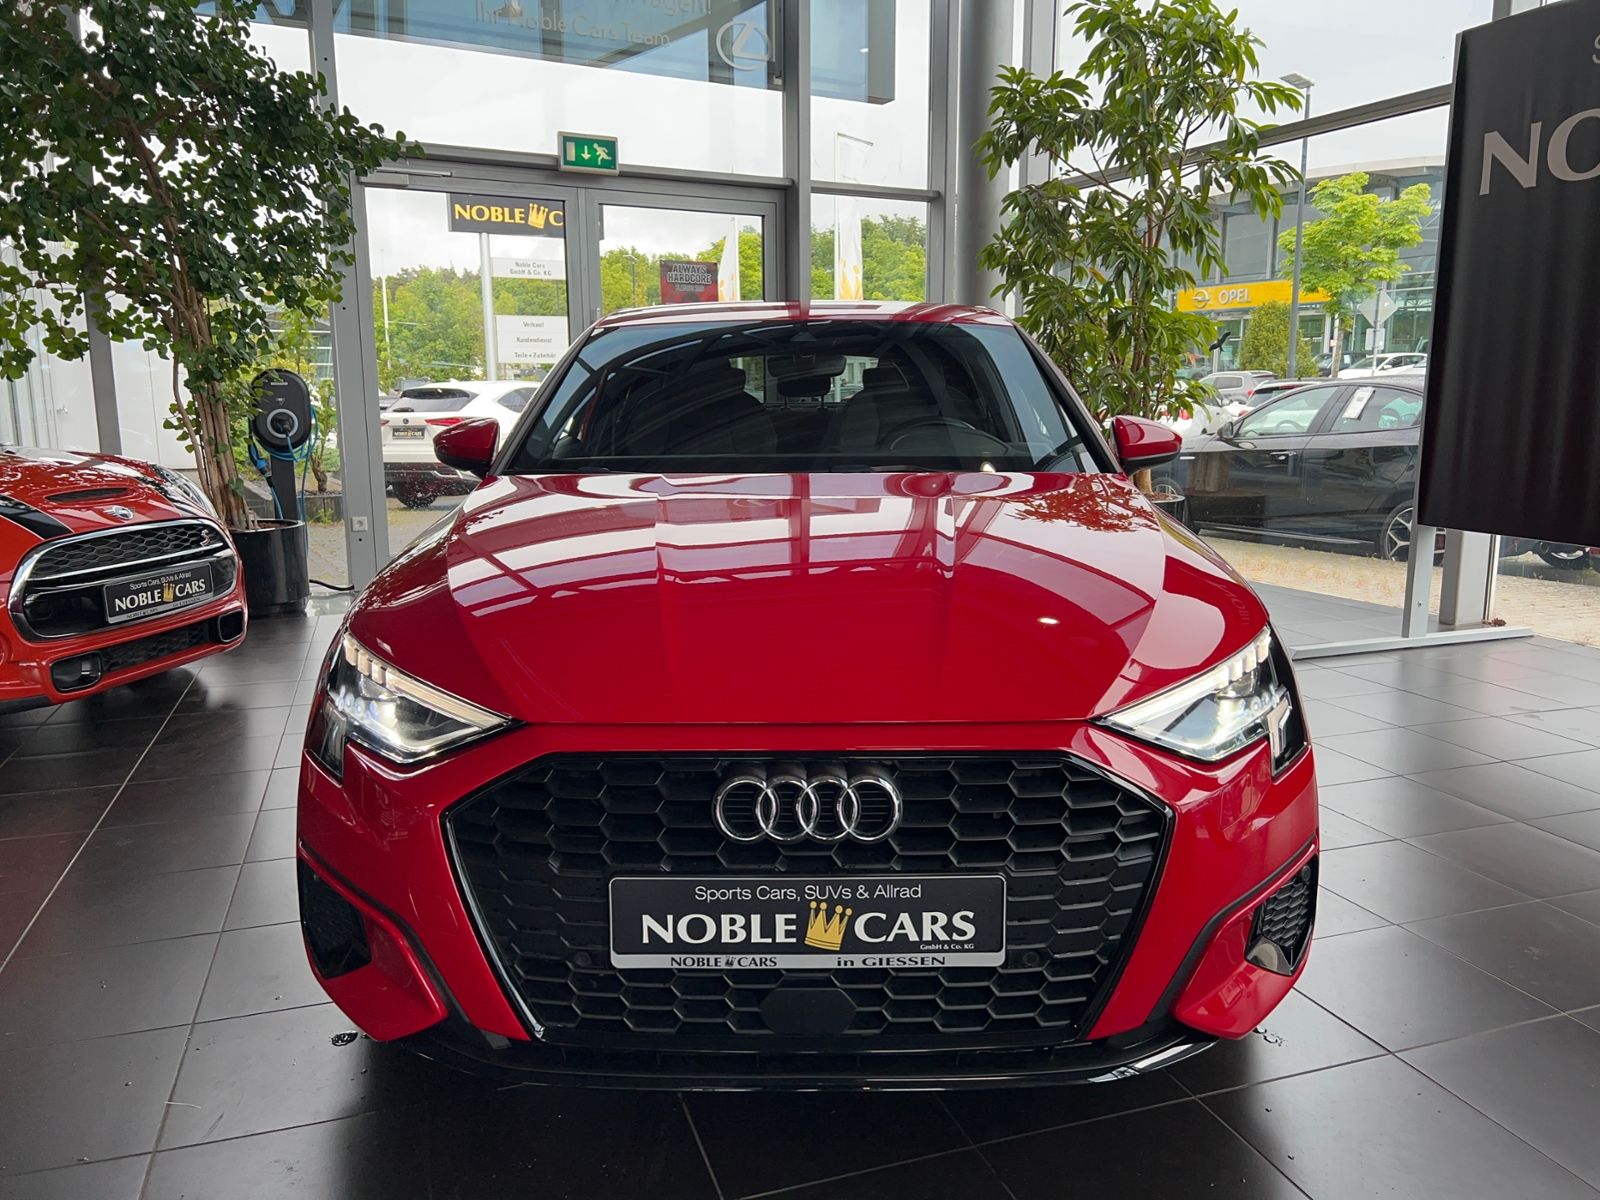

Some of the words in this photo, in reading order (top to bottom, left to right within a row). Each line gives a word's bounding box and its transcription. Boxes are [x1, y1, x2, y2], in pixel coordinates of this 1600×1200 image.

[572, 15, 621, 40] Cars
[623, 21, 670, 46] Team
[454, 203, 526, 224] NOBLE
[515, 261, 531, 269] Noble
[672, 263, 708, 274] ALWAYS
[667, 272, 712, 285] HARDCORE
[1219, 288, 1250, 304] OPEL
[114, 589, 162, 612] NOBLE
[175, 579, 206, 597] CARS
[695, 885, 752, 903] Sports
[756, 885, 800, 901] Cars,
[804, 885, 852, 899] SUVs
[856, 884, 870, 899] &
[873, 884, 922, 898] Allrad
[642, 913, 797, 944] NOBLE
[854, 910, 976, 943] CARS
[670, 956, 722, 967] NOBLE
[737, 956, 777, 967] CARS
[837, 957, 854, 967] in
[862, 956, 946, 967] GIESSEN
